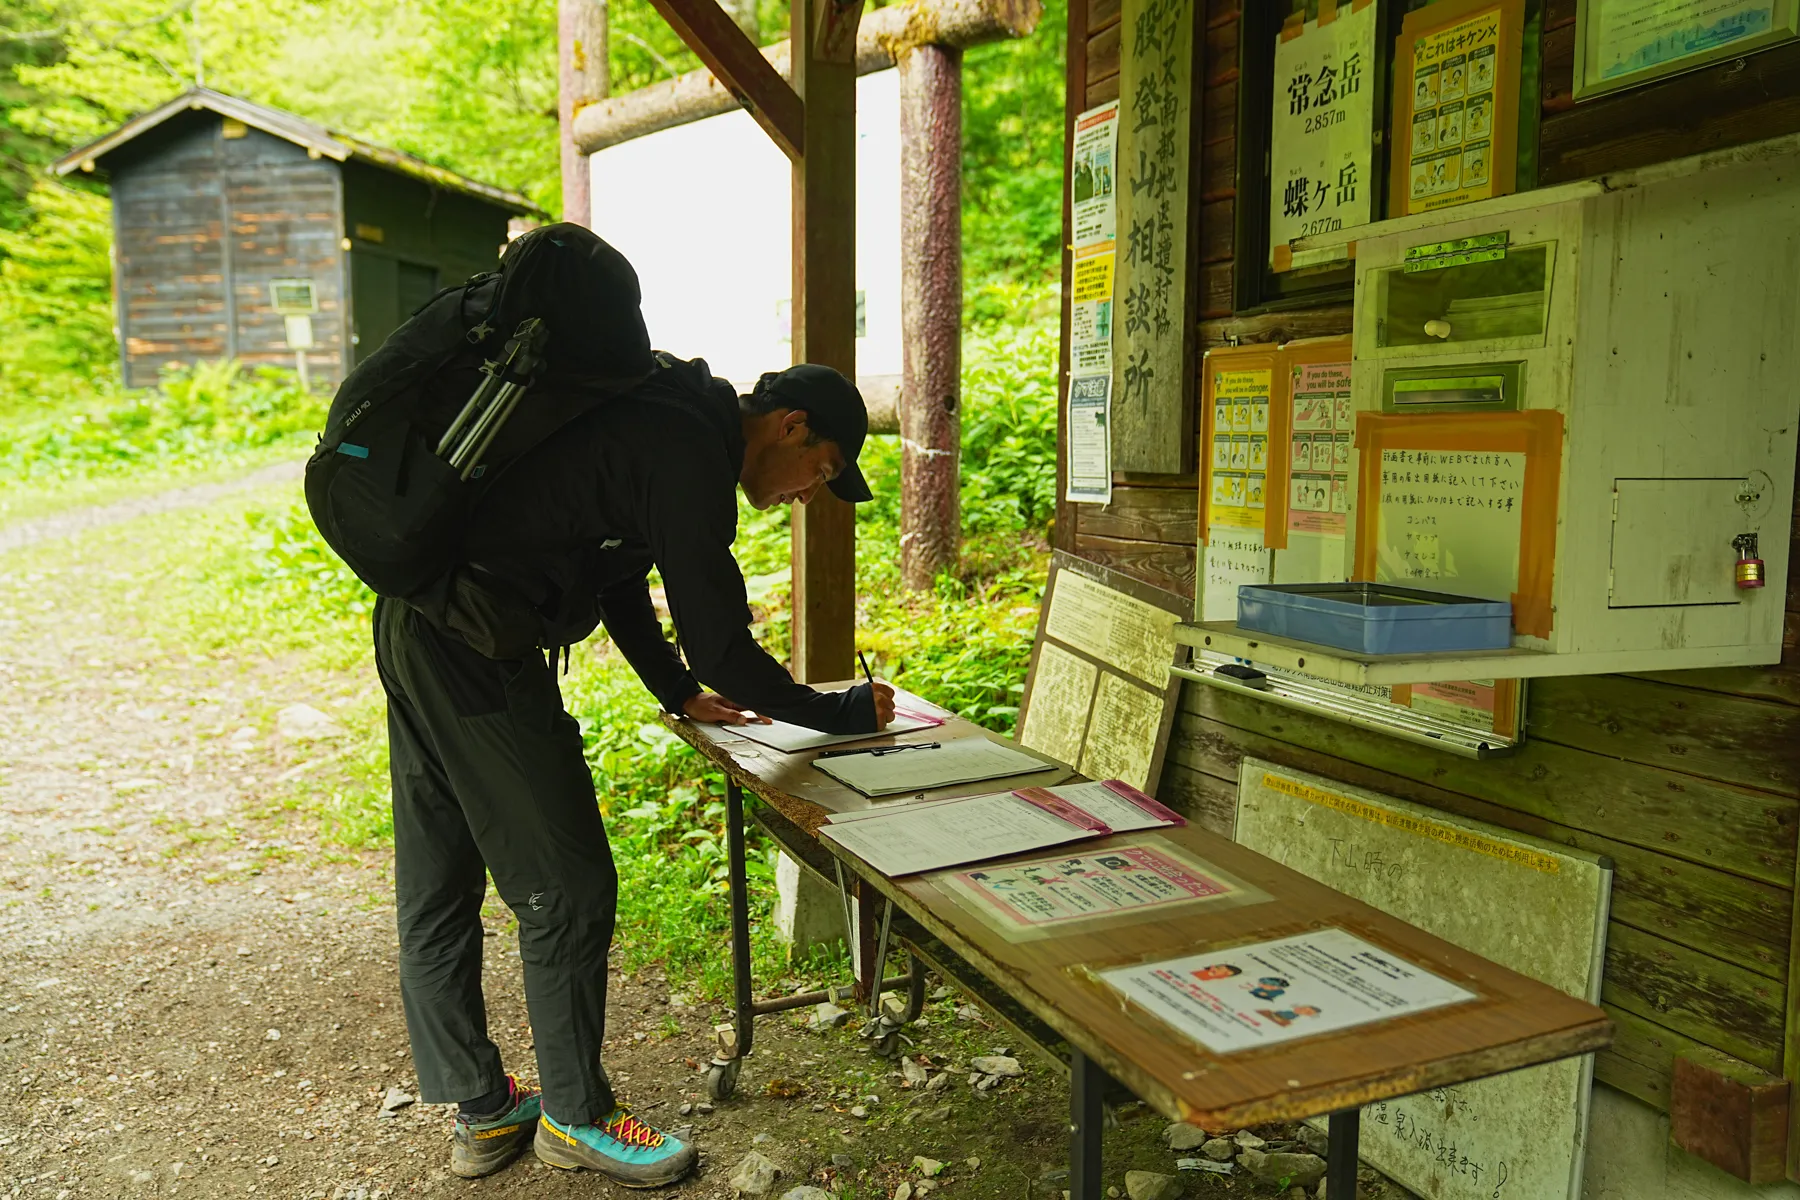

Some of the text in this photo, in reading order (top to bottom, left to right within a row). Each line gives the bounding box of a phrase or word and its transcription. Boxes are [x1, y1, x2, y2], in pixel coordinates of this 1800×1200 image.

[1287, 52, 1362, 115] 常念岳
[1304, 109, 1346, 135] 2,857m
[1311, 372, 1321, 380] you
[1306, 382, 1317, 391] you
[1317, 380, 1327, 388] will
[1328, 380, 1335, 388] be
[345, 407, 362, 426] ZULU
[1407, 515, 1436, 525] コンパス
[1406, 532, 1438, 541] ヤマップ
[1405, 550, 1436, 560] ヤマレコ
[1329, 838, 1402, 882] 下山時の
